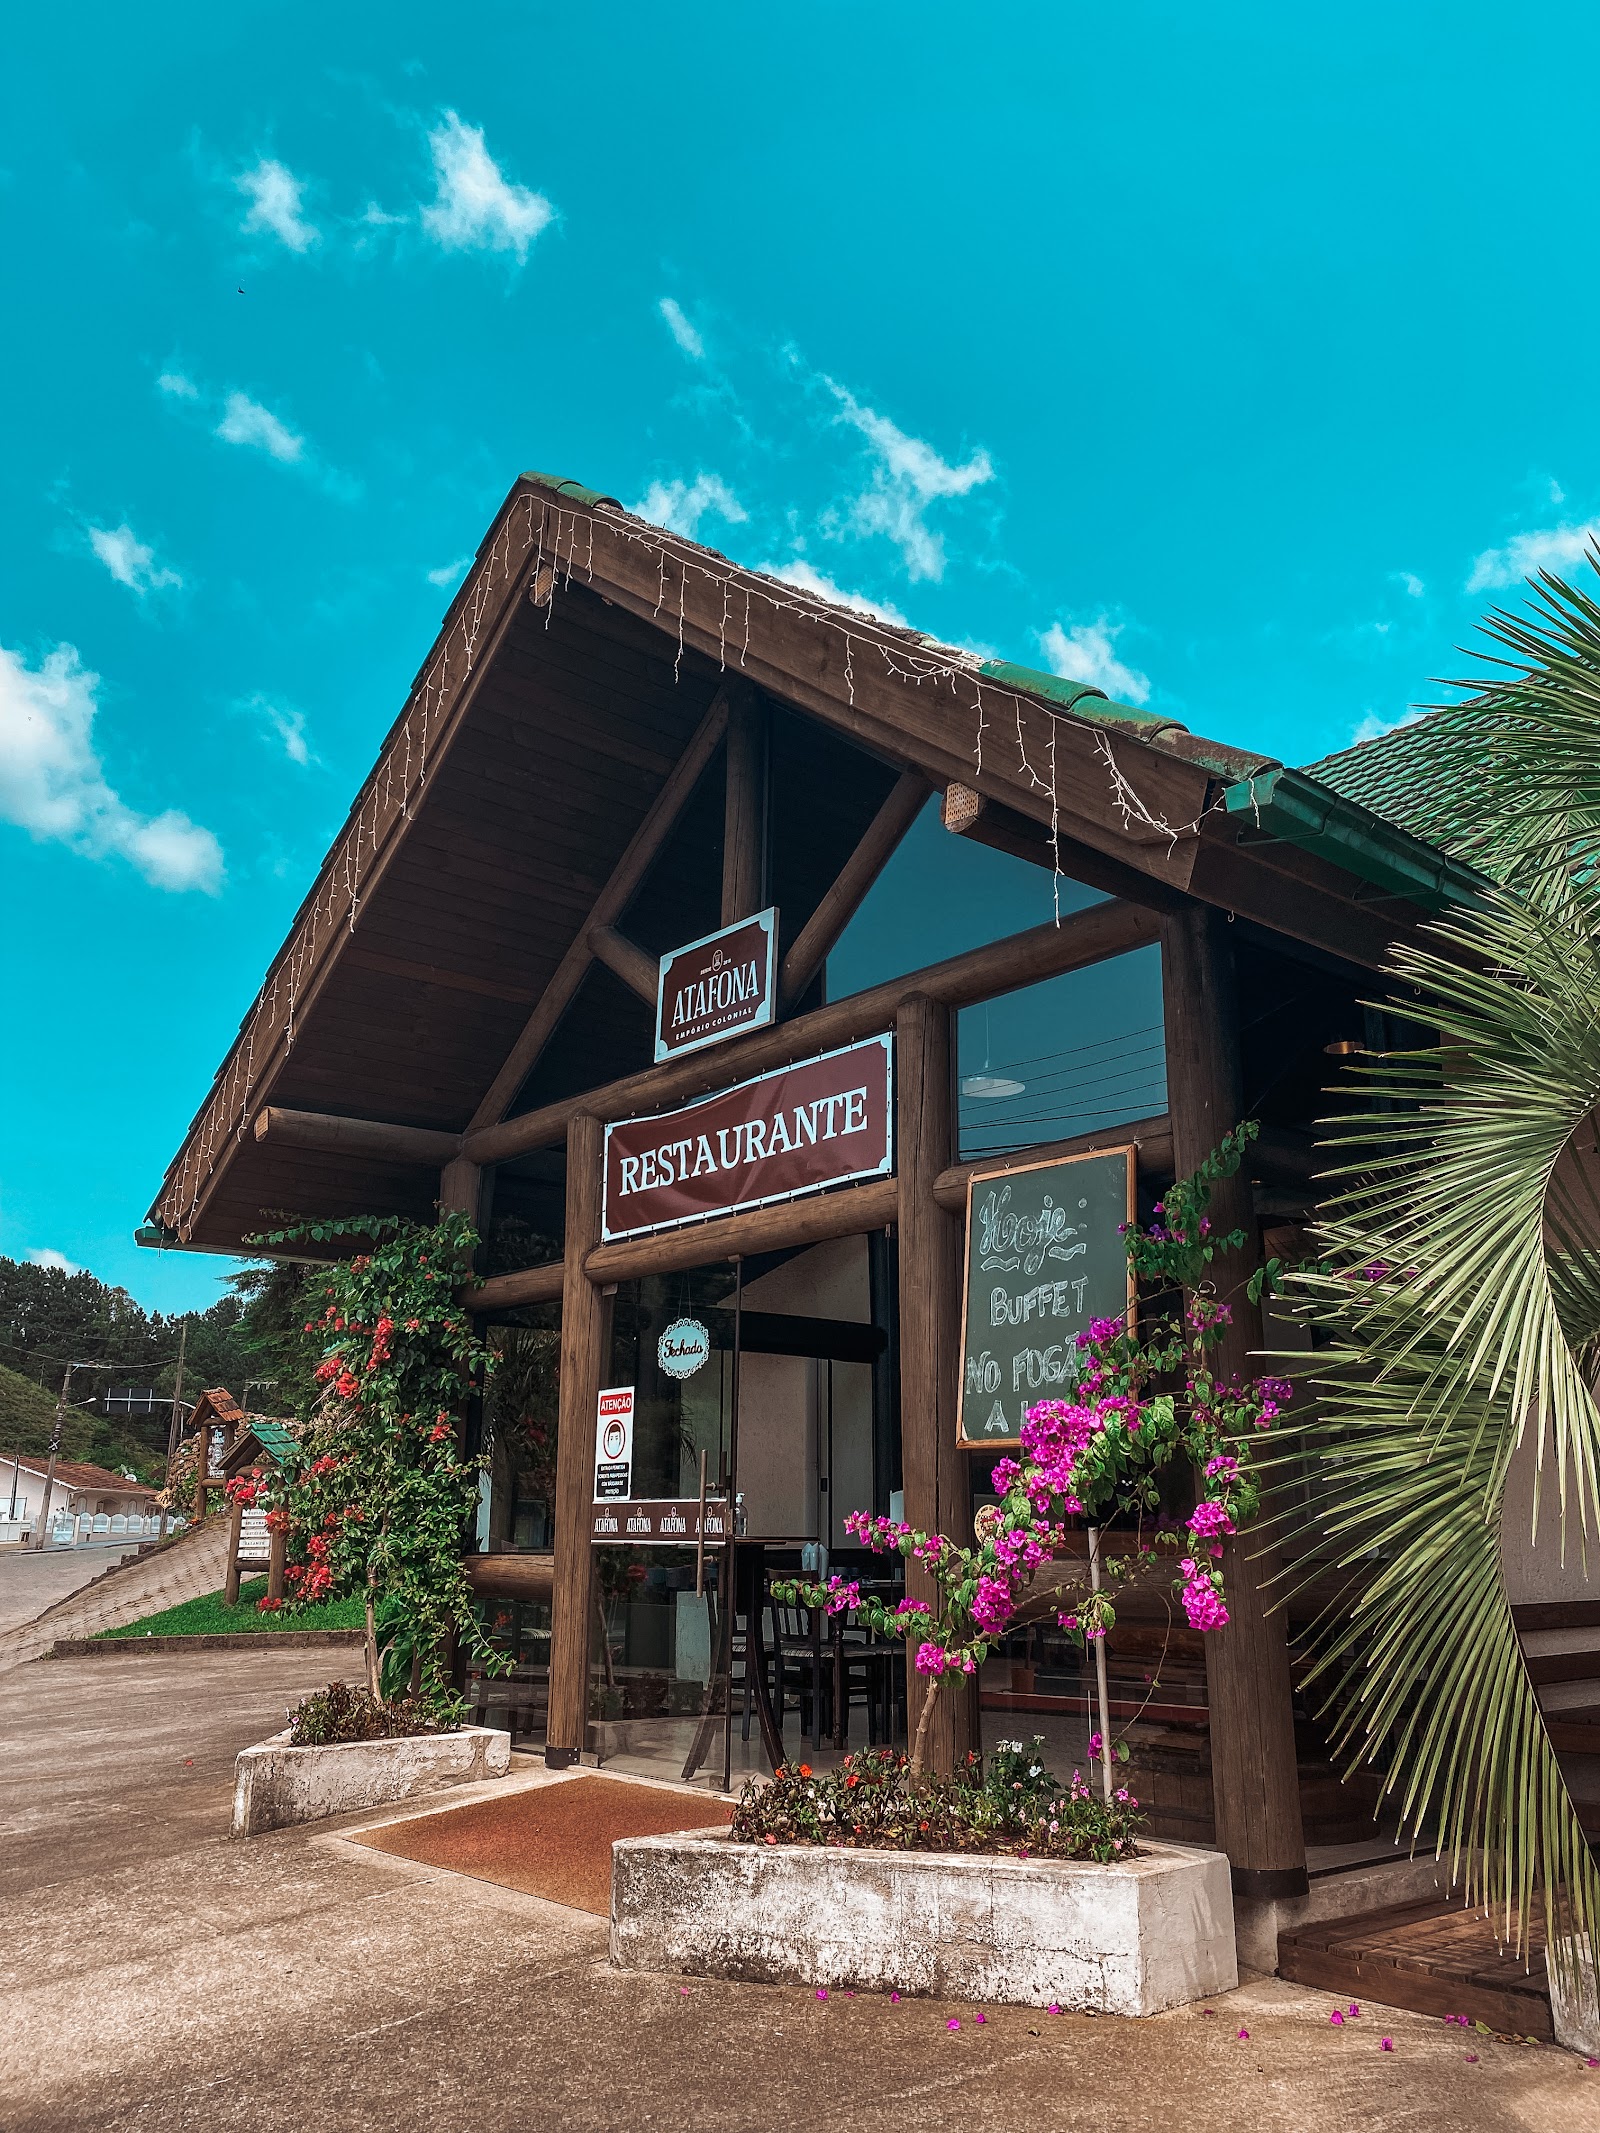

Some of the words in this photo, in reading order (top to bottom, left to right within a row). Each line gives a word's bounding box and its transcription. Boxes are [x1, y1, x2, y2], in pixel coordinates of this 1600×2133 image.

[671, 959, 760, 1028] ATAFONA
[675, 1022, 710, 1041] EMPÓRIO
[712, 1006, 753, 1027] COLONIAL
[618, 1085, 869, 1197] RESTAURANTE
[990, 1275, 1089, 1327] BUFFET
[663, 1338, 704, 1359] Fechado
[966, 1351, 1002, 1395] NO
[600, 1394, 632, 1413] ATENÇÃO
[983, 1399, 1010, 1433] A
[594, 1517, 619, 1533] ATAFONA
[626, 1517, 652, 1533] ATAFONA
[659, 1517, 687, 1533] ATAFONA
